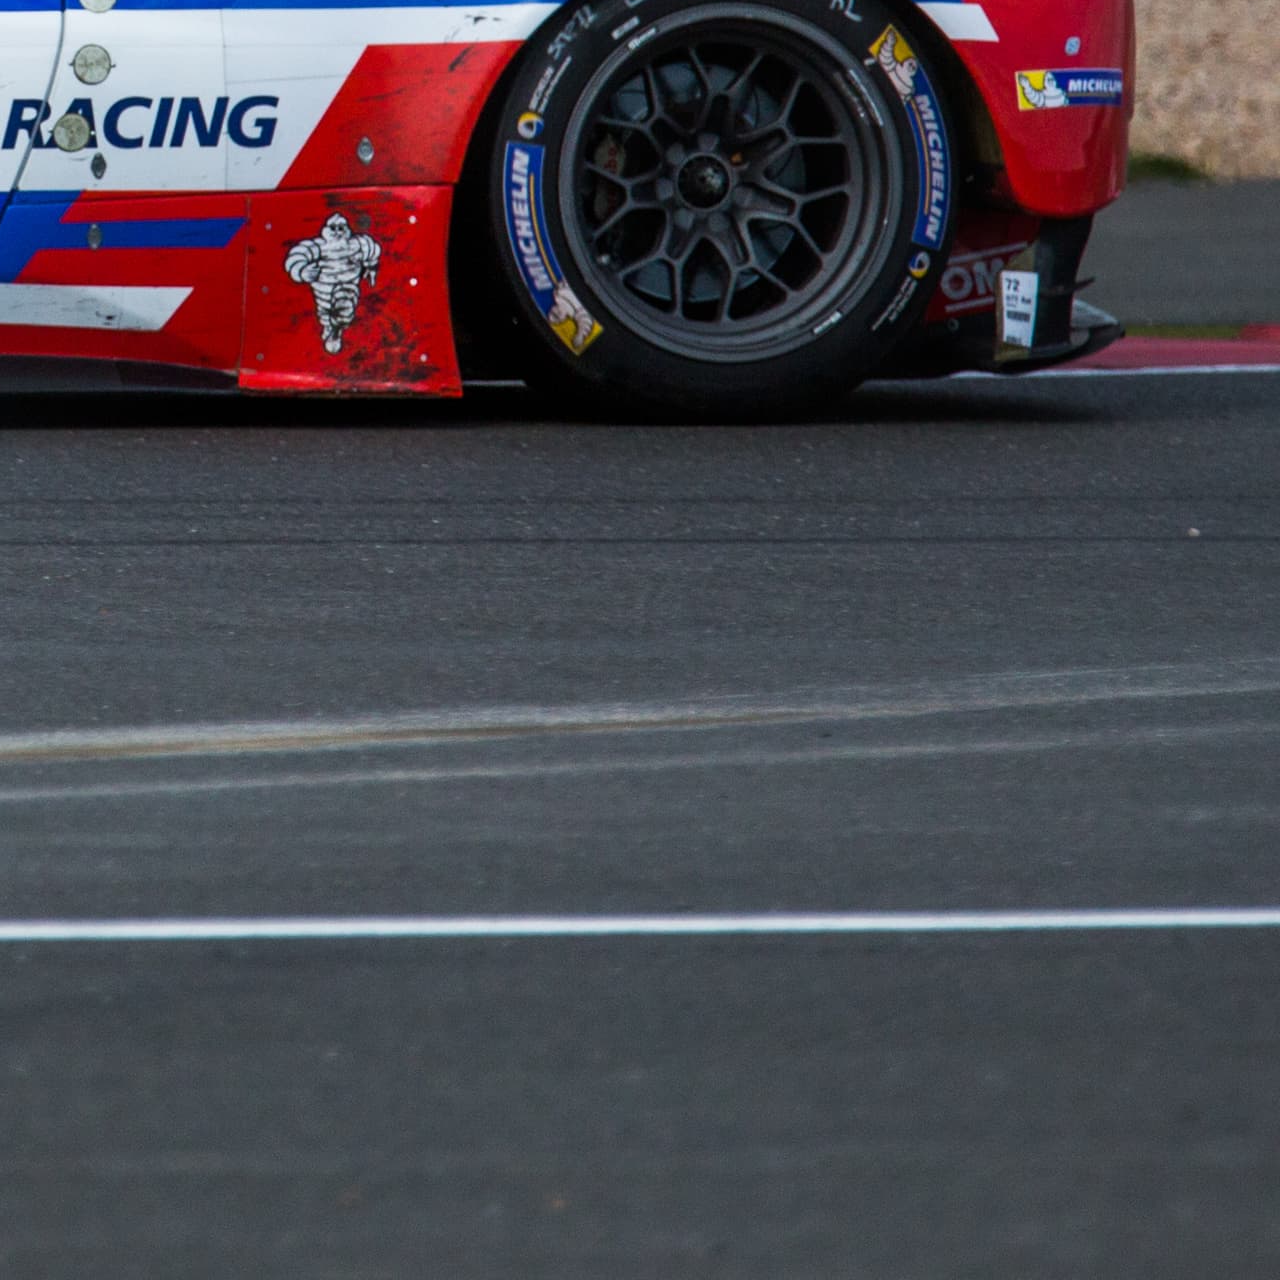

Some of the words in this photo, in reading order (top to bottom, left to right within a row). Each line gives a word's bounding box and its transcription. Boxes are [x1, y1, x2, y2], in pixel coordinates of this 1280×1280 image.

[1, 95, 280, 151] RACING
[915, 94, 947, 242] MICHELIN
[511, 148, 553, 291] MICHELIN
